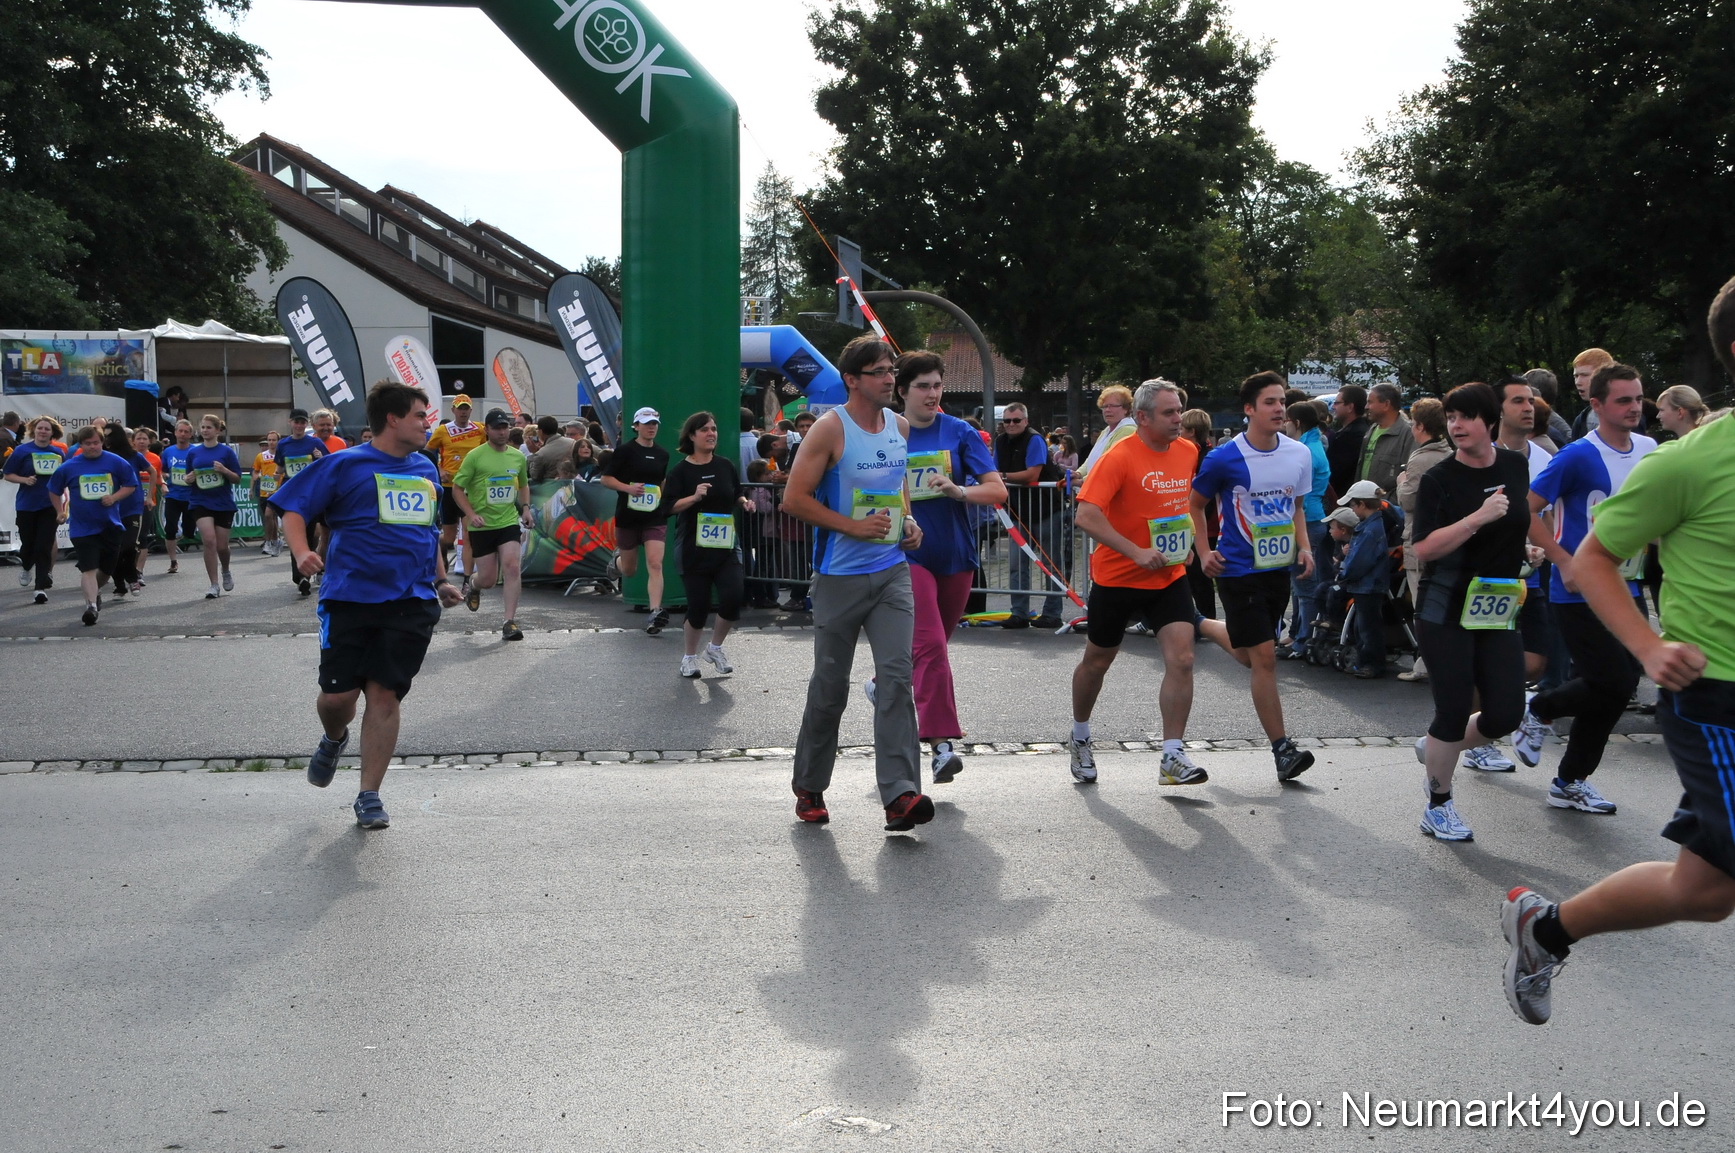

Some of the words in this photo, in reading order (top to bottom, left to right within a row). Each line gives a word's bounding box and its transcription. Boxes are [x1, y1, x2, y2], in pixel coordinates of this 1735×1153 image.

[7, 353, 60, 370] TLA
[67, 361, 130, 379] Logistics
[36, 460, 56, 469] 127
[199, 473, 219, 484] 133
[1151, 478, 1188, 489] Fischer
[84, 482, 107, 493] 165
[489, 487, 512, 499] 367
[1250, 489, 1282, 498] expert
[385, 490, 425, 512] 162
[631, 493, 654, 505] 519
[701, 525, 727, 539] 541
[1156, 530, 1186, 553] 981
[1258, 536, 1290, 557] 660
[1469, 595, 1511, 616] 536
